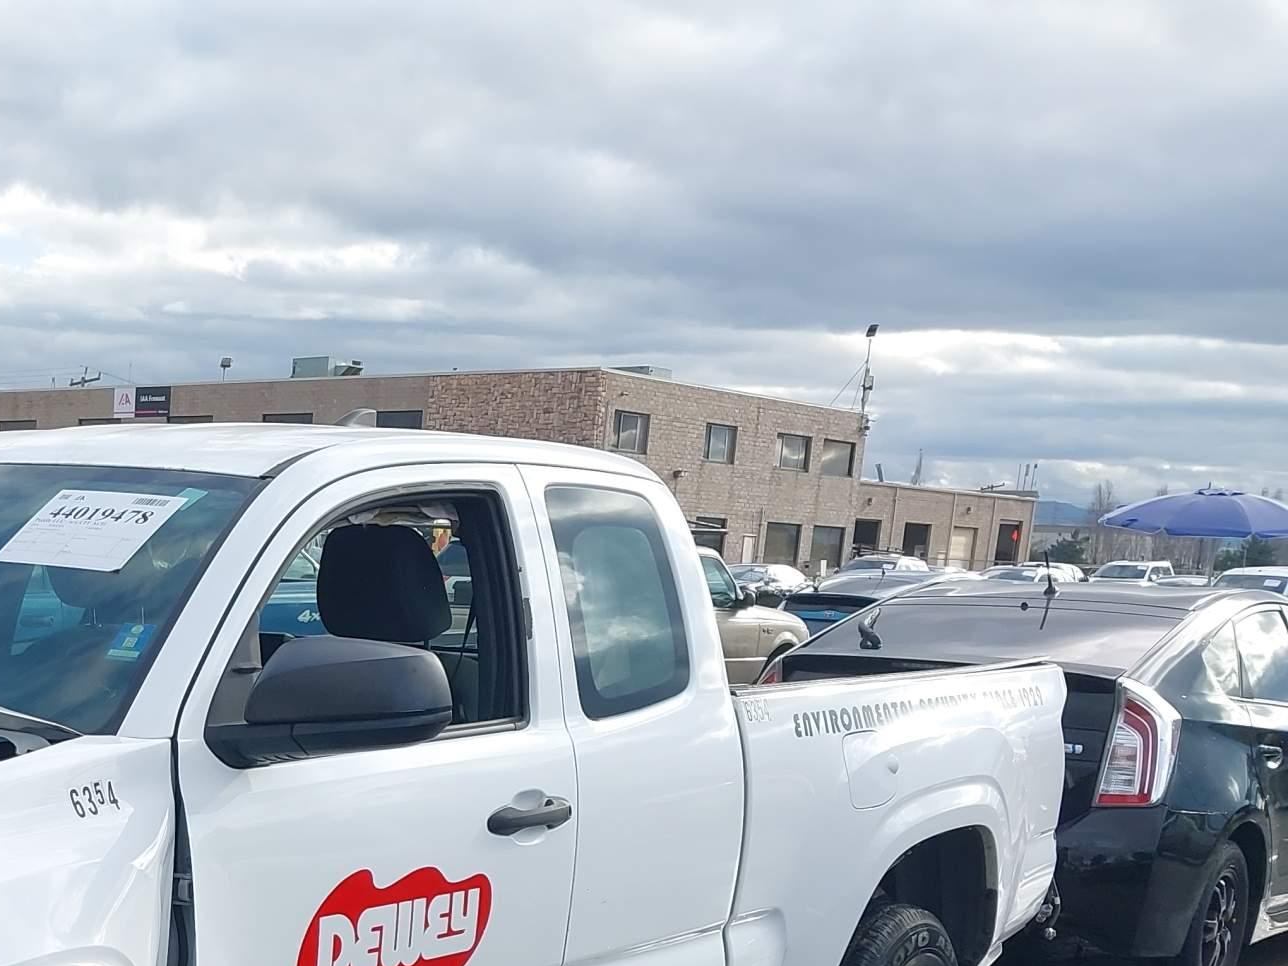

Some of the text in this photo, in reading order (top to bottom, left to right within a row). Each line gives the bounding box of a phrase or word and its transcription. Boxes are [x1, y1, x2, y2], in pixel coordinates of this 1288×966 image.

[49, 506, 154, 525] 44019478
[793, 700, 914, 738] ENVIRONMENTAL
[70, 781, 120, 818] 6354
